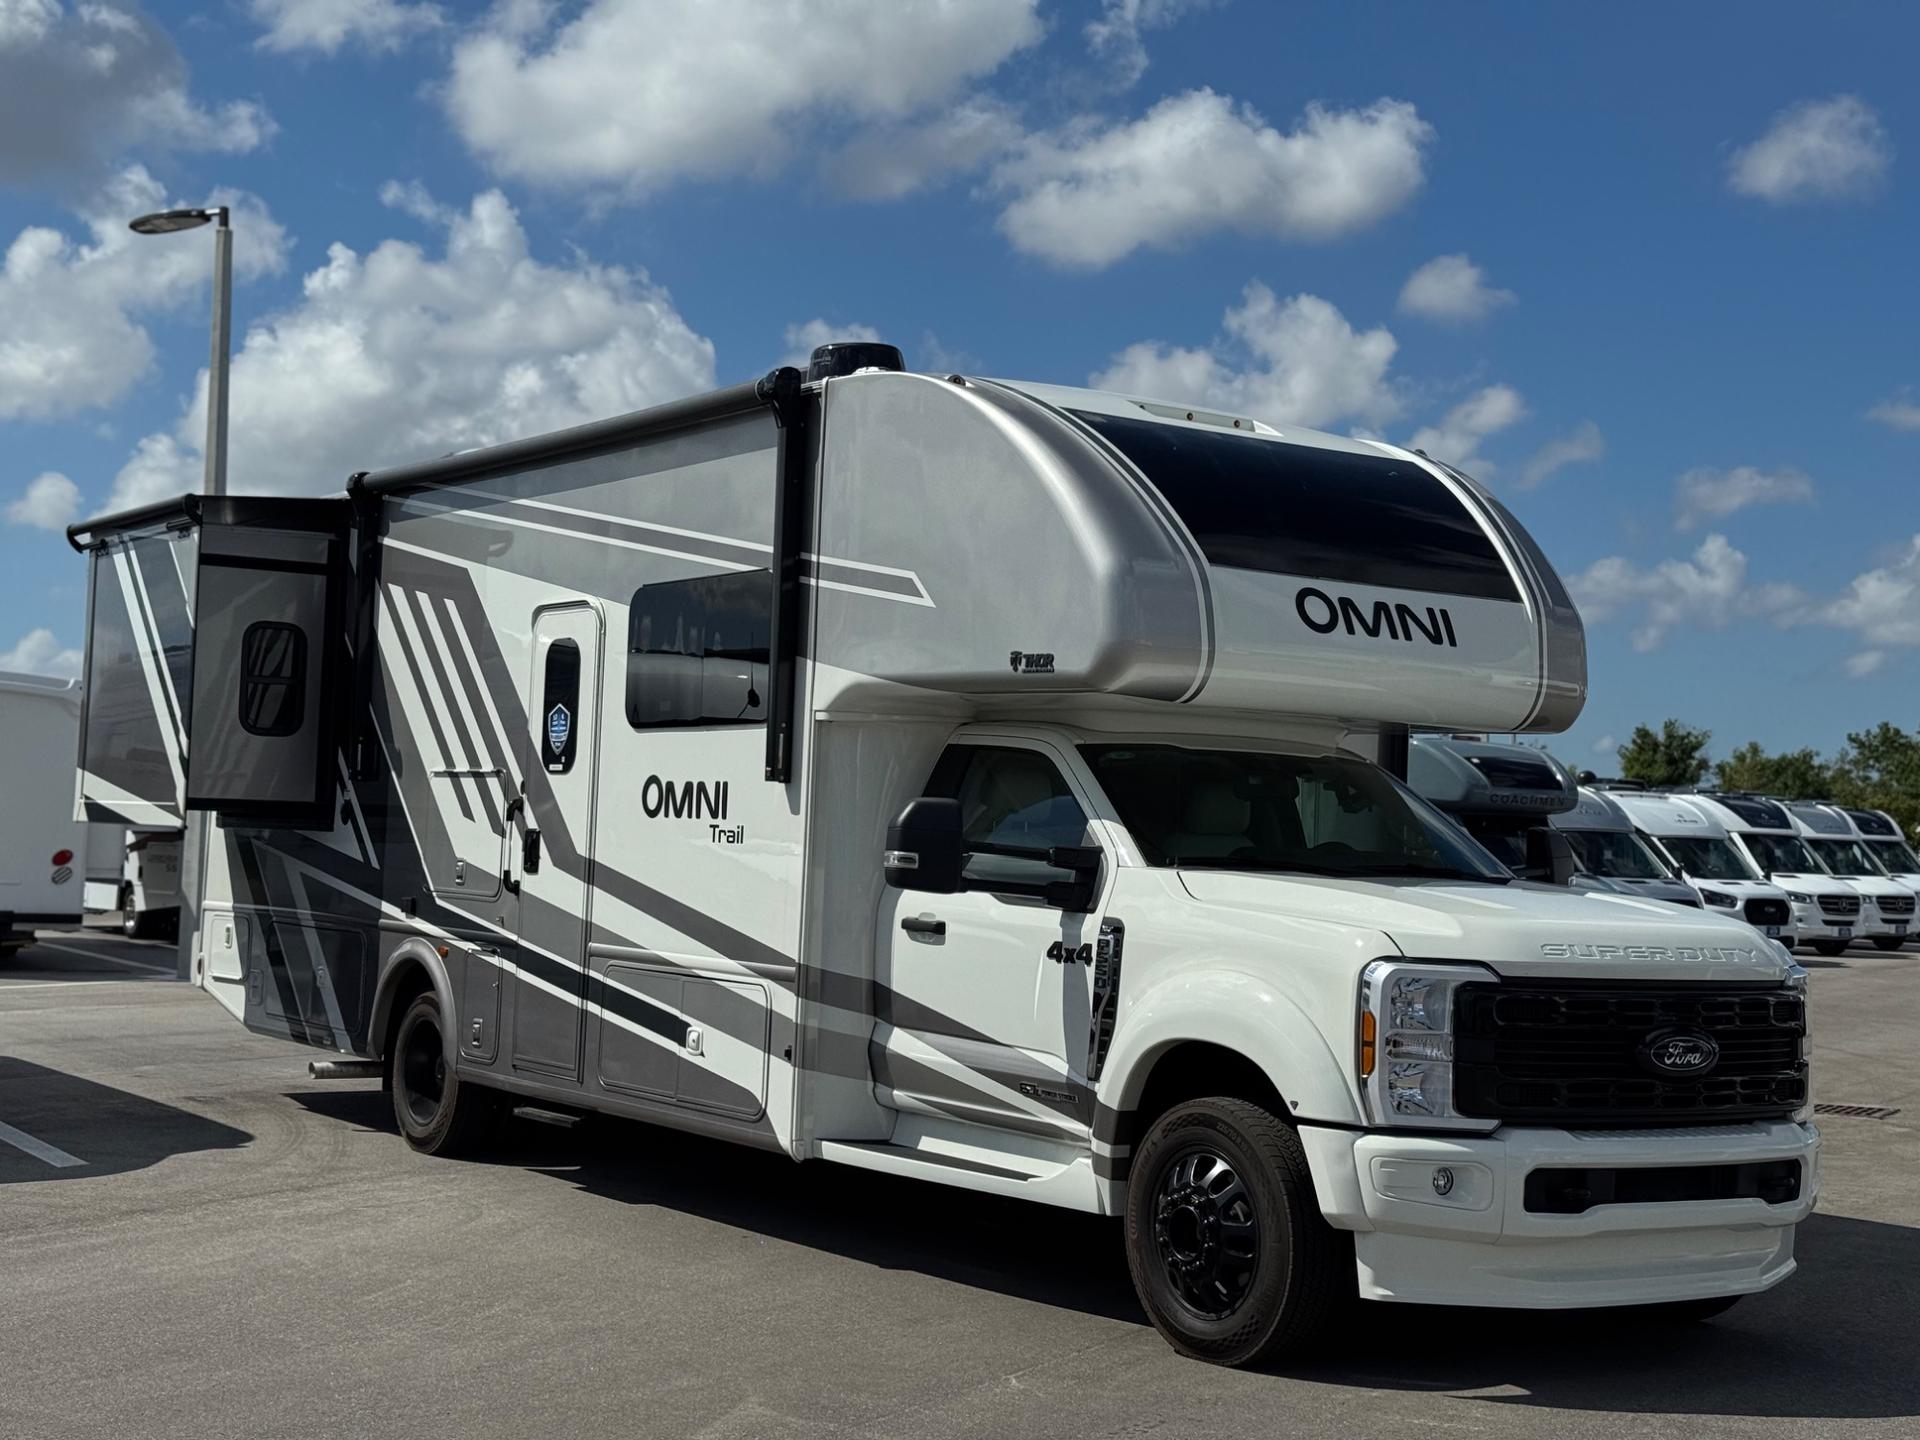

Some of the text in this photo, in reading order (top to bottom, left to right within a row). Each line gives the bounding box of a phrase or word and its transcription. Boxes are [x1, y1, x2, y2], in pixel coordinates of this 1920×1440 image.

[1295, 587, 1457, 648] OMNI
[1022, 653, 1055, 668] THOR
[641, 774, 729, 821] OMNI
[1490, 793, 1566, 807] COACHMEN
[709, 824, 744, 844] Trail
[1046, 941, 1093, 967] 4x4
[1541, 943, 1757, 962] SUPER DUTY
[1664, 1041, 1702, 1064] Ford
